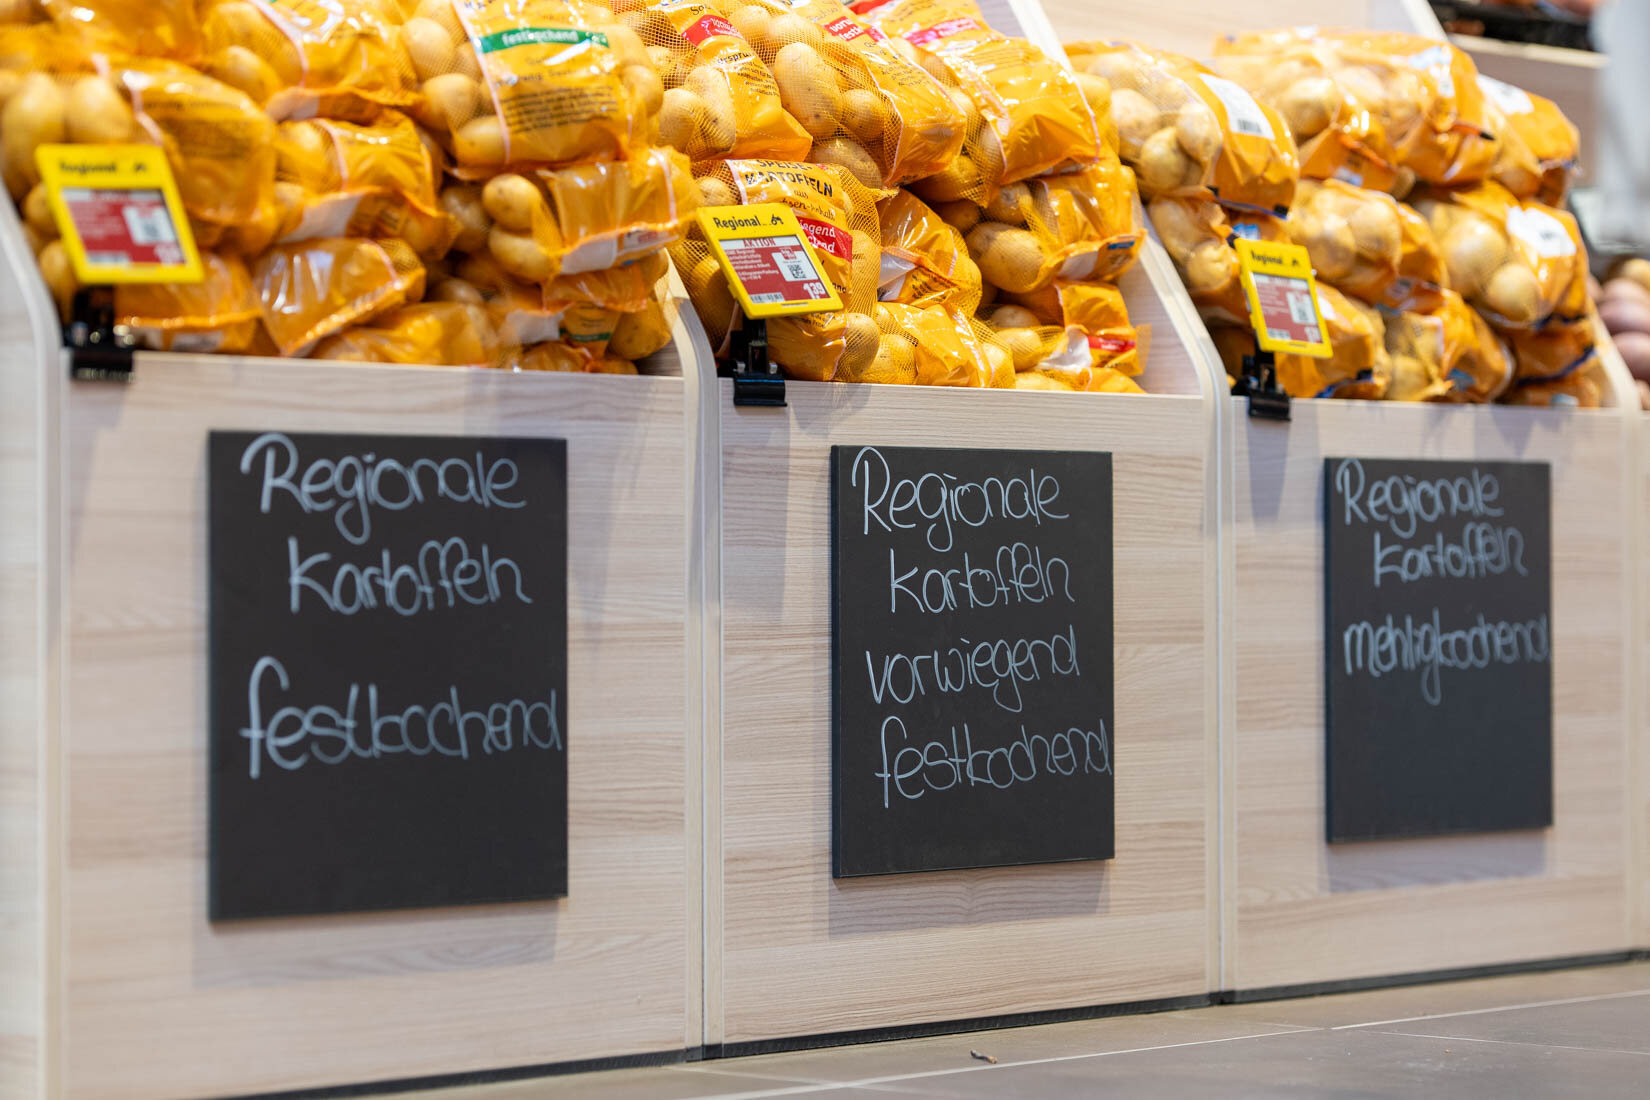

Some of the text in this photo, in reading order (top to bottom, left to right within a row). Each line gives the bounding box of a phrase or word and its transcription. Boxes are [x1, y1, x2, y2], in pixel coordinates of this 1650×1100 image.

[713, 216, 760, 230] Regional
[743, 238, 777, 248] AKTION
[800, 219, 836, 238] iegend
[240, 432, 527, 545] Regionale
[852, 447, 1069, 552] Regionale
[1336, 457, 1505, 539] Regionale
[865, 624, 1080, 712] vorwiegend
[1344, 607, 1551, 705] mehligkochend
[239, 656, 563, 780] festkochend
[875, 715, 1112, 809] festkochend
